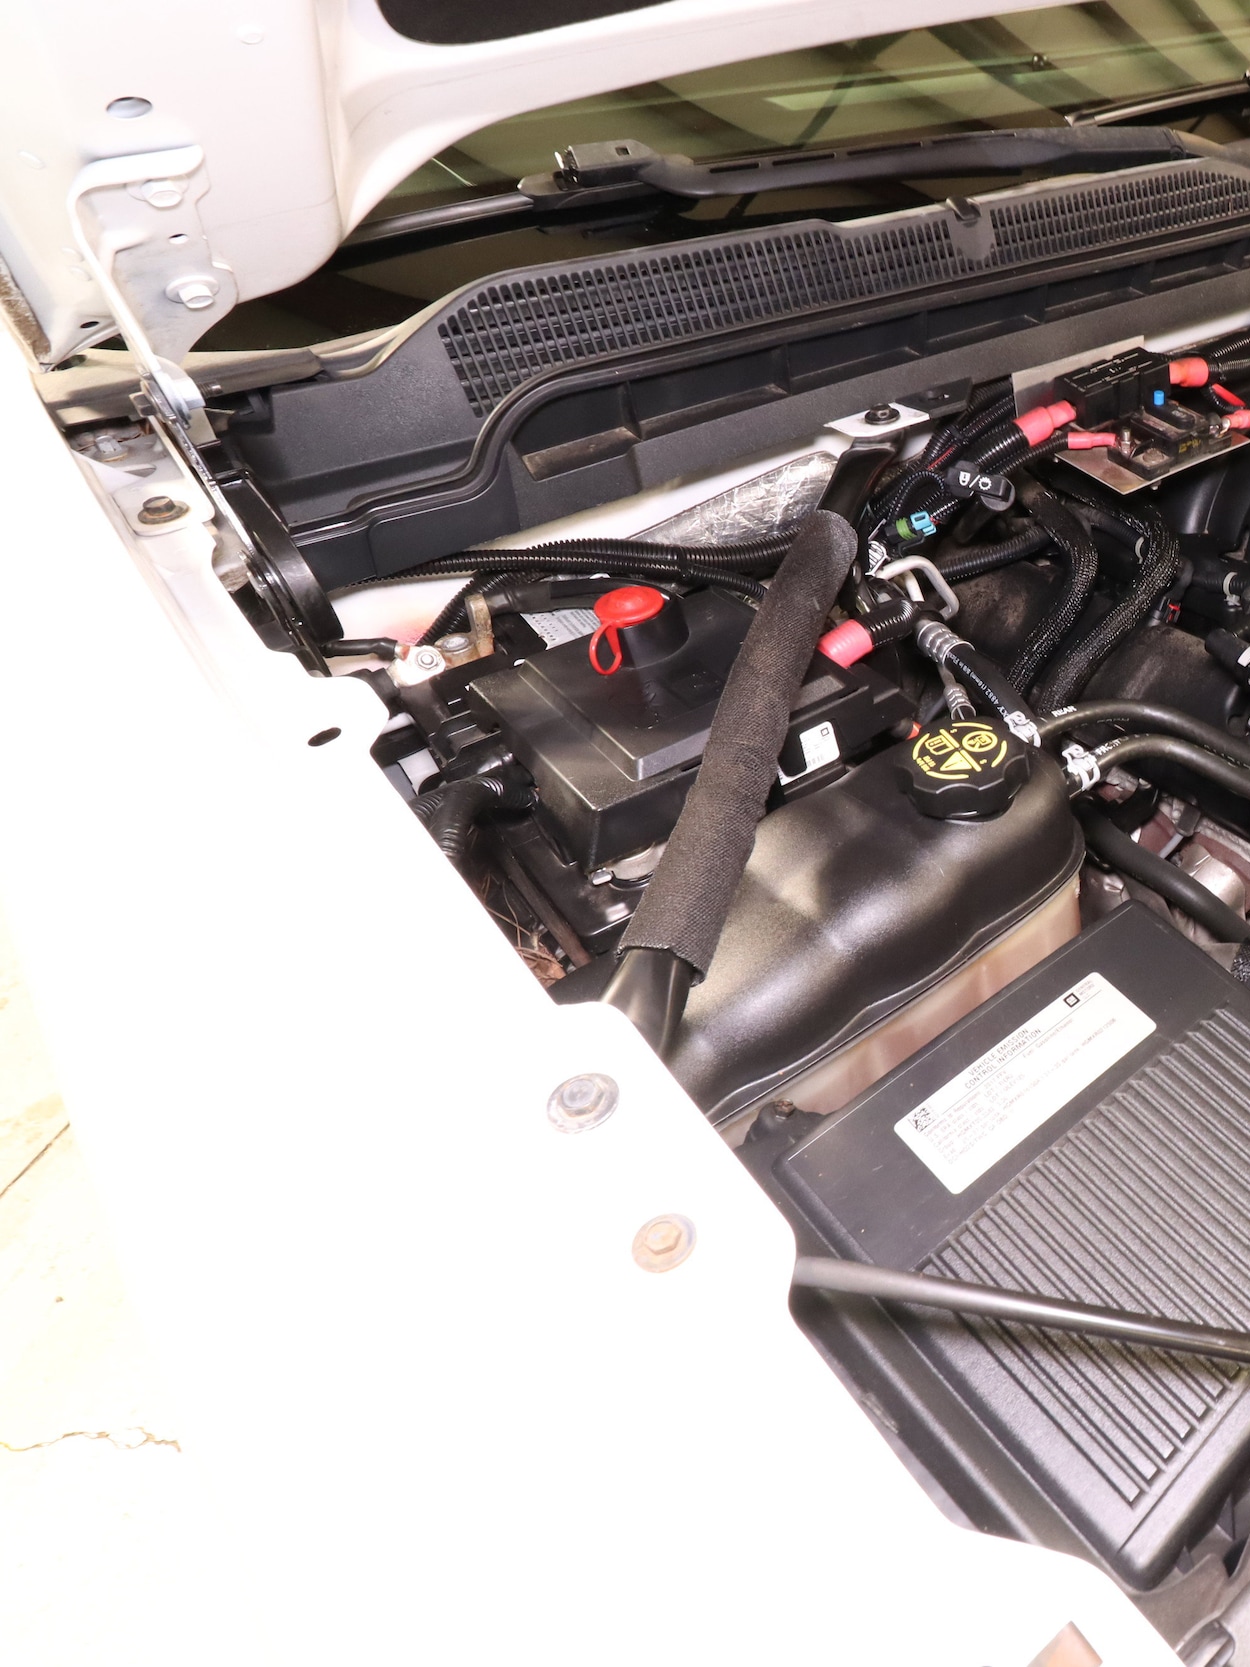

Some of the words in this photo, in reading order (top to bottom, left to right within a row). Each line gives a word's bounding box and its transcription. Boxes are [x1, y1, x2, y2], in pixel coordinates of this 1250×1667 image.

[984, 687, 999, 704] 4882
[1051, 705, 1077, 718] REAR
[965, 1063, 996, 1089] CONTROL
[997, 1029, 1041, 1064] INFORMATION
[968, 1053, 996, 1075] VEHICLE
[997, 1029, 1028, 1054] EMISSION
